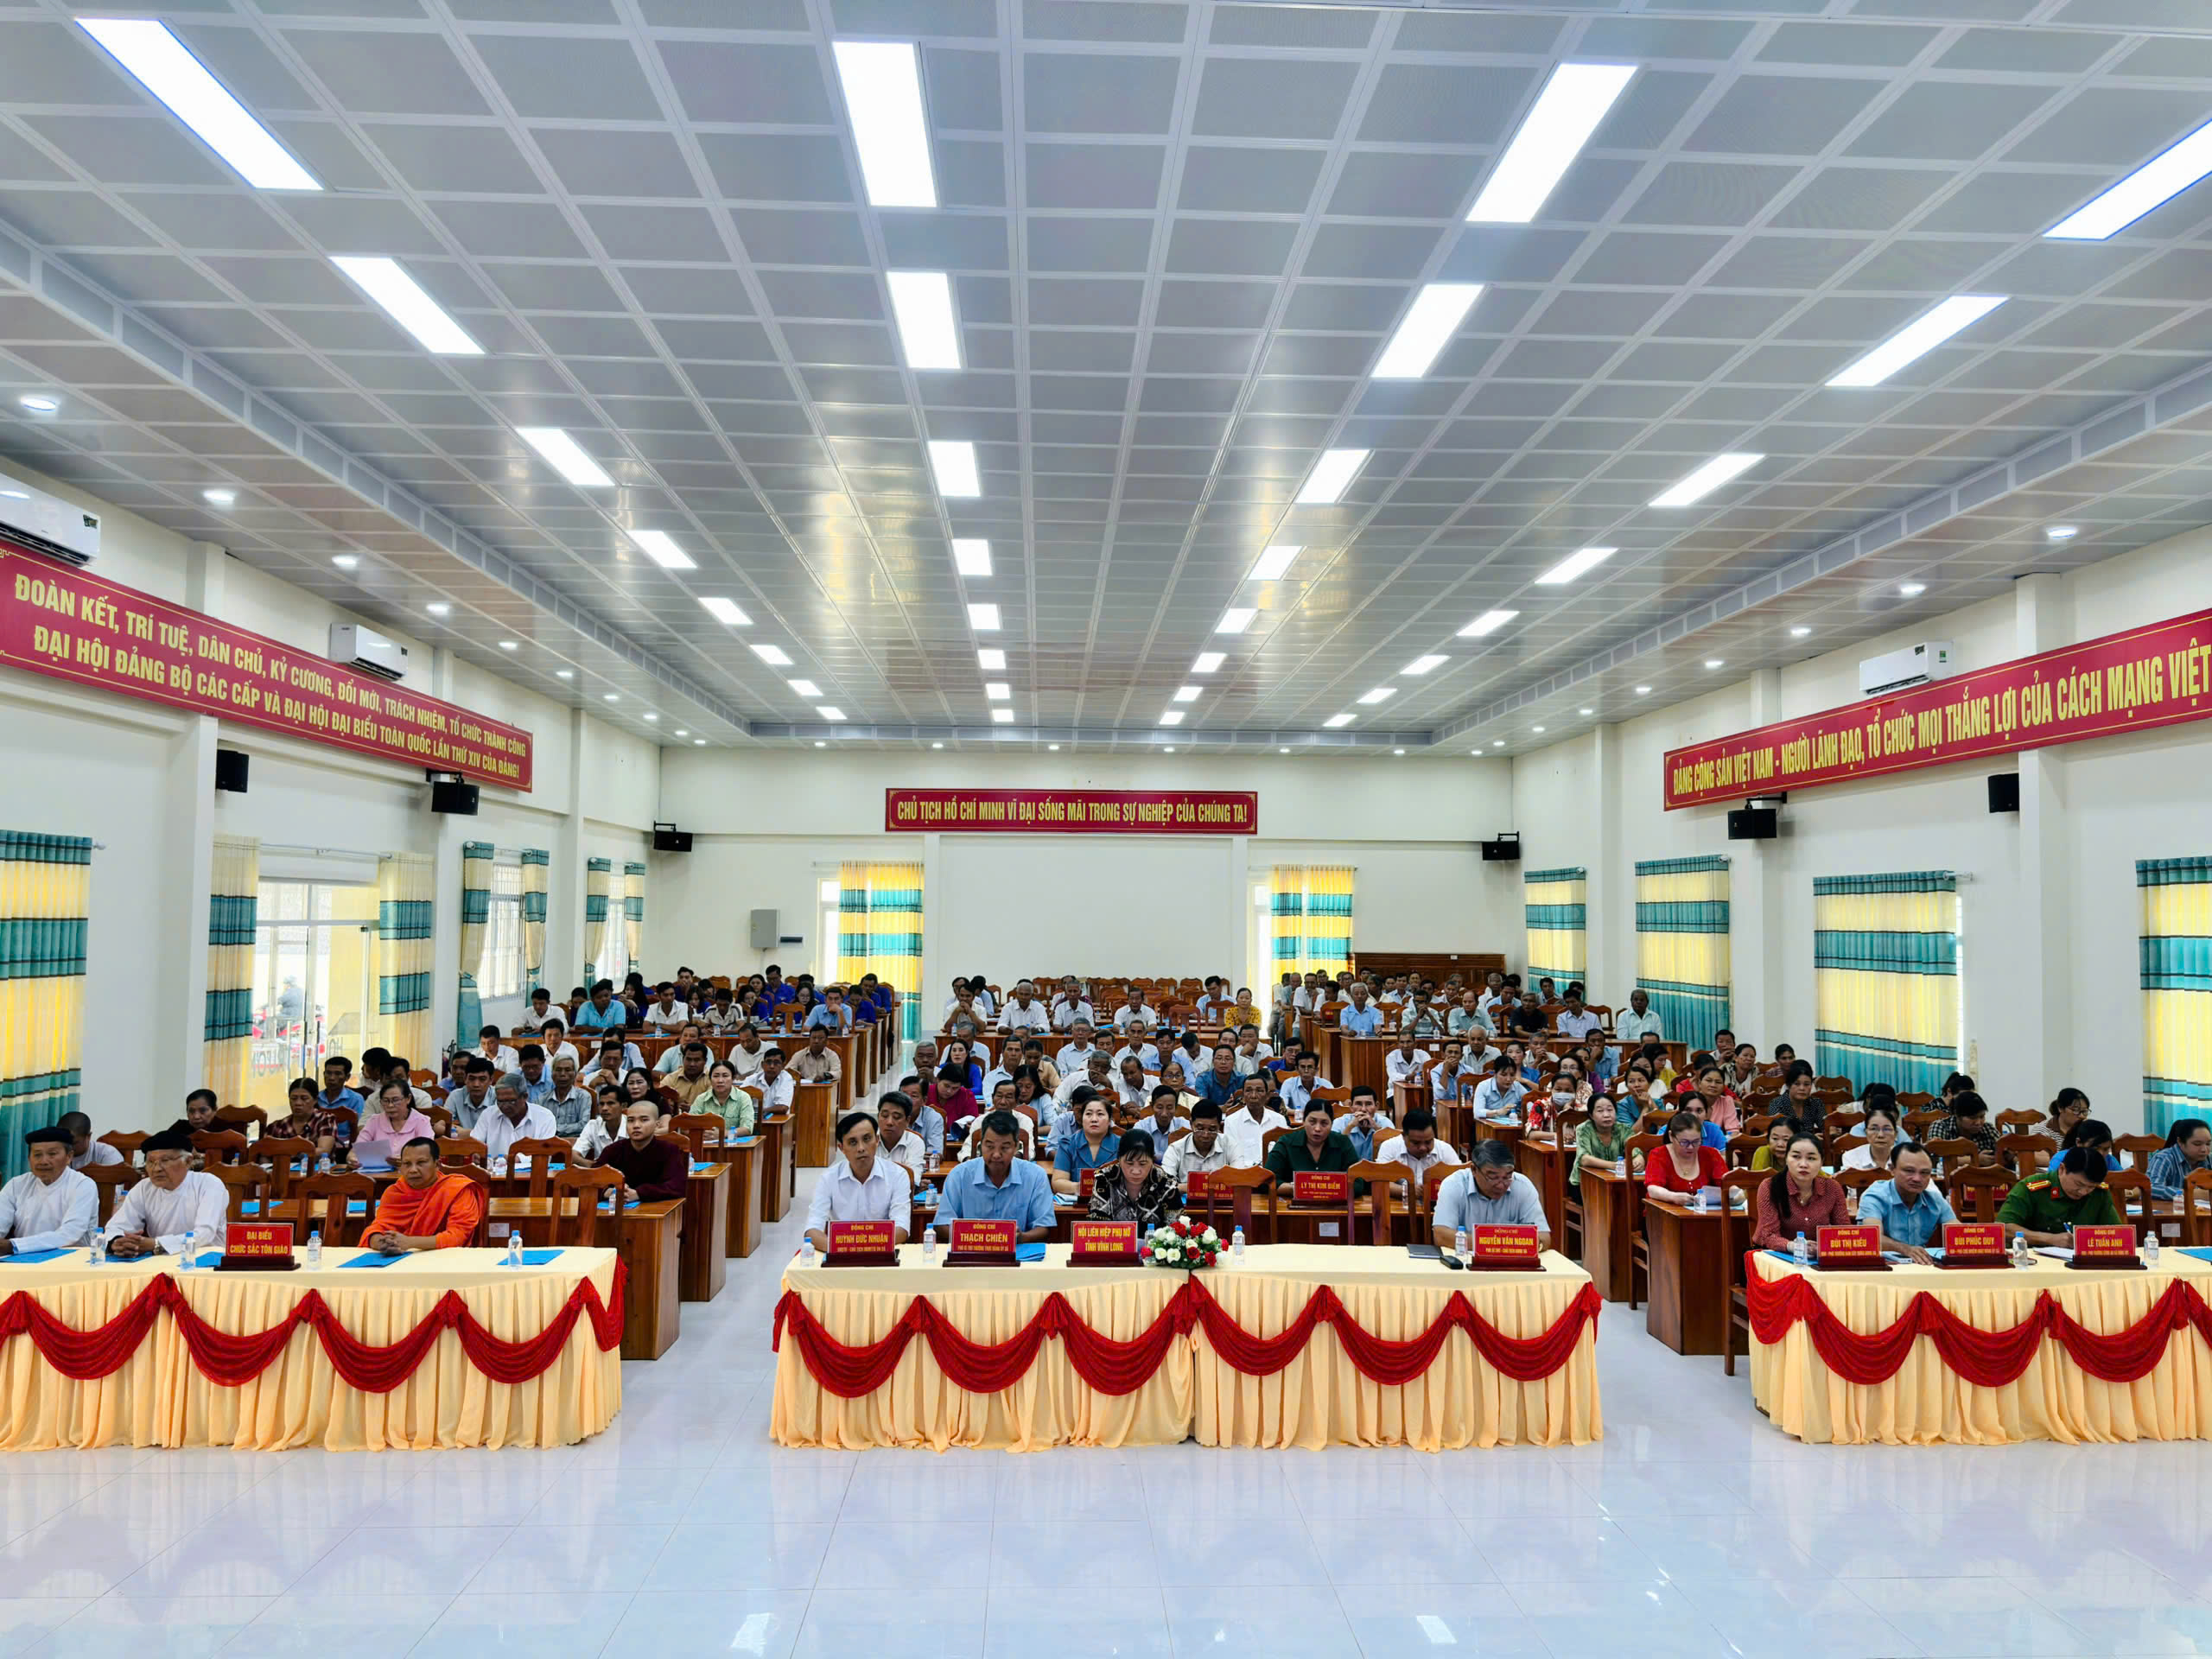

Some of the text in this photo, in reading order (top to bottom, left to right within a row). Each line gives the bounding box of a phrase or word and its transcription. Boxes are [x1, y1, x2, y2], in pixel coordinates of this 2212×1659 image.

[15, 573, 75, 617] ĐOÀN
[81, 595, 119, 633] KẾT,
[125, 610, 154, 641] TRÍ
[159, 621, 193, 657] TUỆ,
[198, 635, 230, 664] DÂN
[234, 646, 266, 678] CHỦ,
[270, 656, 288, 682] KỶ
[290, 666, 334, 700] CƯƠNG,
[338, 678, 357, 704] ĐỔI
[359, 689, 382, 715] MỚI,
[385, 697, 415, 722] TRÁCH
[417, 709, 448, 733] NHIỆM,
[461, 723, 482, 742] CHỨC
[483, 729, 506, 751] THÀNH
[508, 738, 526, 757] CÔNG
[34, 625, 71, 662] ĐẠI
[76, 637, 110, 672] HỘI
[115, 645, 165, 684] ĐẢNG
[170, 664, 192, 696] BỘ
[197, 671, 228, 700] CÁC
[232, 680, 260, 708] CẤP
[264, 690, 281, 715] VÀ
[284, 697, 306, 724] ĐẠI
[308, 703, 328, 730] HỘI
[332, 711, 351, 736] ĐẠI
[353, 715, 378, 741] BIỂU
[380, 726, 405, 747] TOÀN
[407, 732, 431, 753] QUỐC
[451, 746, 467, 764] THỨ
[468, 750, 481, 767] XIV
[482, 752, 497, 772] CỦA
[1674, 759, 1693, 795] ĐẢNG
[1694, 757, 1715, 797] CỘNG
[1716, 747, 1732, 787] SẢN
[1734, 747, 1751, 789] VIỆT
[1753, 747, 1773, 780] NAM
[1781, 732, 1810, 775] NGƯỜI
[1812, 729, 1840, 770] LÃNH
[1840, 727, 1865, 770] ĐẠO,
[1866, 708, 1881, 760] TỔ
[1884, 709, 1915, 756] CHỨC
[1918, 707, 1942, 754] MỌI
[1945, 686, 1990, 743] THẮNG
[1993, 686, 2017, 741] LỢI
[2021, 670, 2053, 728] CỦA
[2056, 665, 2102, 721] CÁCH
[2107, 656, 2164, 718] MẠNG
[2168, 637, 2212, 706] VIỆT
[898, 795, 1248, 826] CHỦ TỊCH HỒ CHÍ MINH VĨ ĐẠI SỐNG MÃI TRONG SỰ NGHIỆP CỦA CHÚNG TA!
[960, 1233, 983, 1243] THẠCH
[1109, 1242, 1123, 1251] LONG
